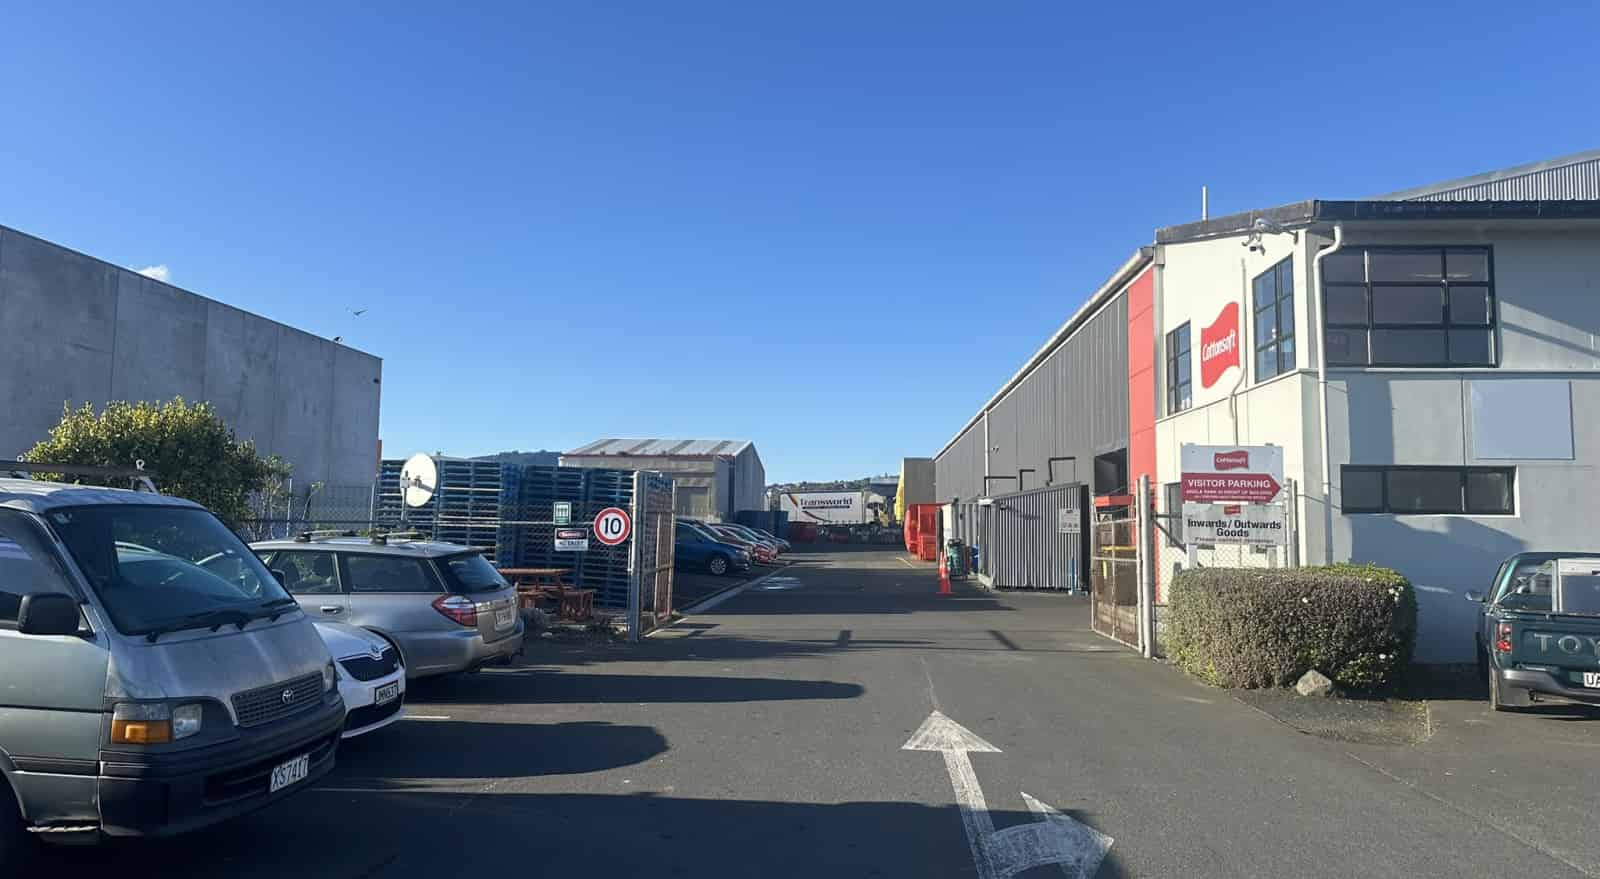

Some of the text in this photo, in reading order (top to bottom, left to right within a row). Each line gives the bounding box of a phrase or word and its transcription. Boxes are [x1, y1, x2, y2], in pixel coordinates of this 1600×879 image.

[1202, 329, 1236, 362] Cottonsoft
[1187, 479, 1271, 489] VISITOR PARKING
[604, 517, 621, 534] 10
[1187, 519, 1227, 528] Inwards
[1233, 519, 1282, 530] Outwards
[1216, 528, 1250, 537] Goods
